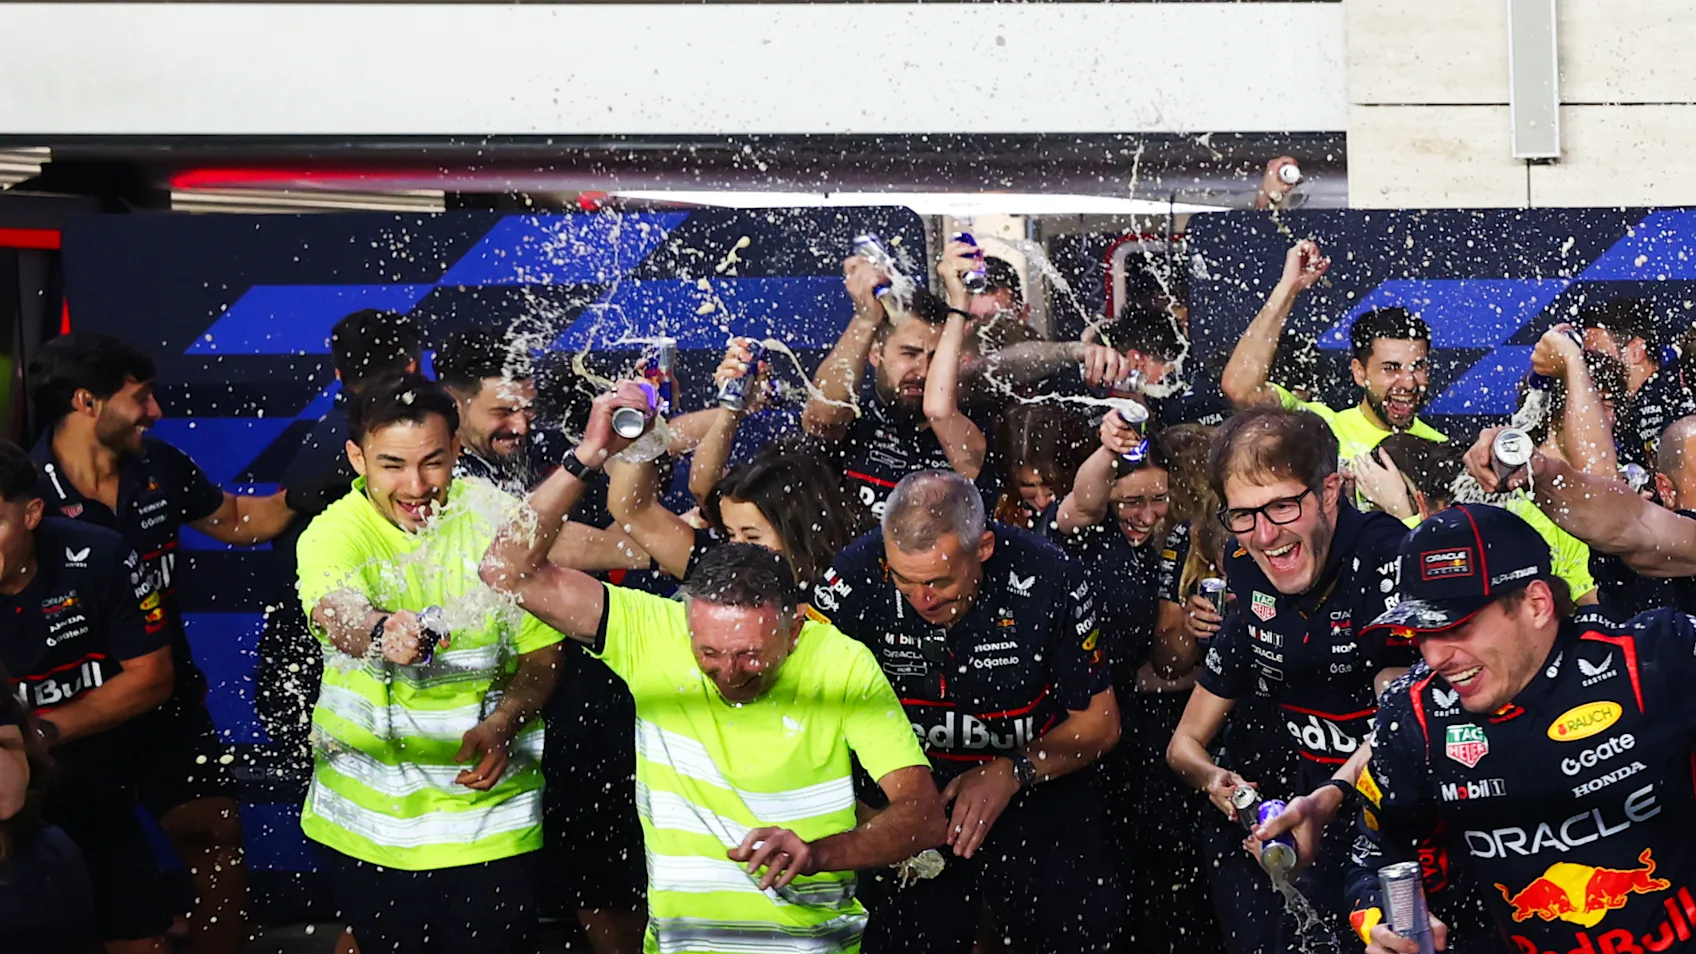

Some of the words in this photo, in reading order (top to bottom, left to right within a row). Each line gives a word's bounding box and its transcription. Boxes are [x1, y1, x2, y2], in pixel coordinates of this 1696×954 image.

[1198, 413, 1225, 426] VISA
[1639, 405, 1662, 415] VISA
[1426, 551, 1467, 563] ORACLE
[1248, 624, 1273, 645] Mobil
[974, 641, 1018, 653] HONDA
[34, 661, 103, 706] Bull
[911, 711, 954, 749] ed
[962, 714, 1034, 749] Bull
[1568, 706, 1613, 732] RAUCH
[1448, 726, 1484, 742] TAG
[1447, 741, 1488, 767] HEUER
[1578, 733, 1636, 768] Gate
[1441, 779, 1490, 802] Mobil
[1572, 761, 1647, 798] HONDA
[1464, 783, 1662, 859] ORACLE
